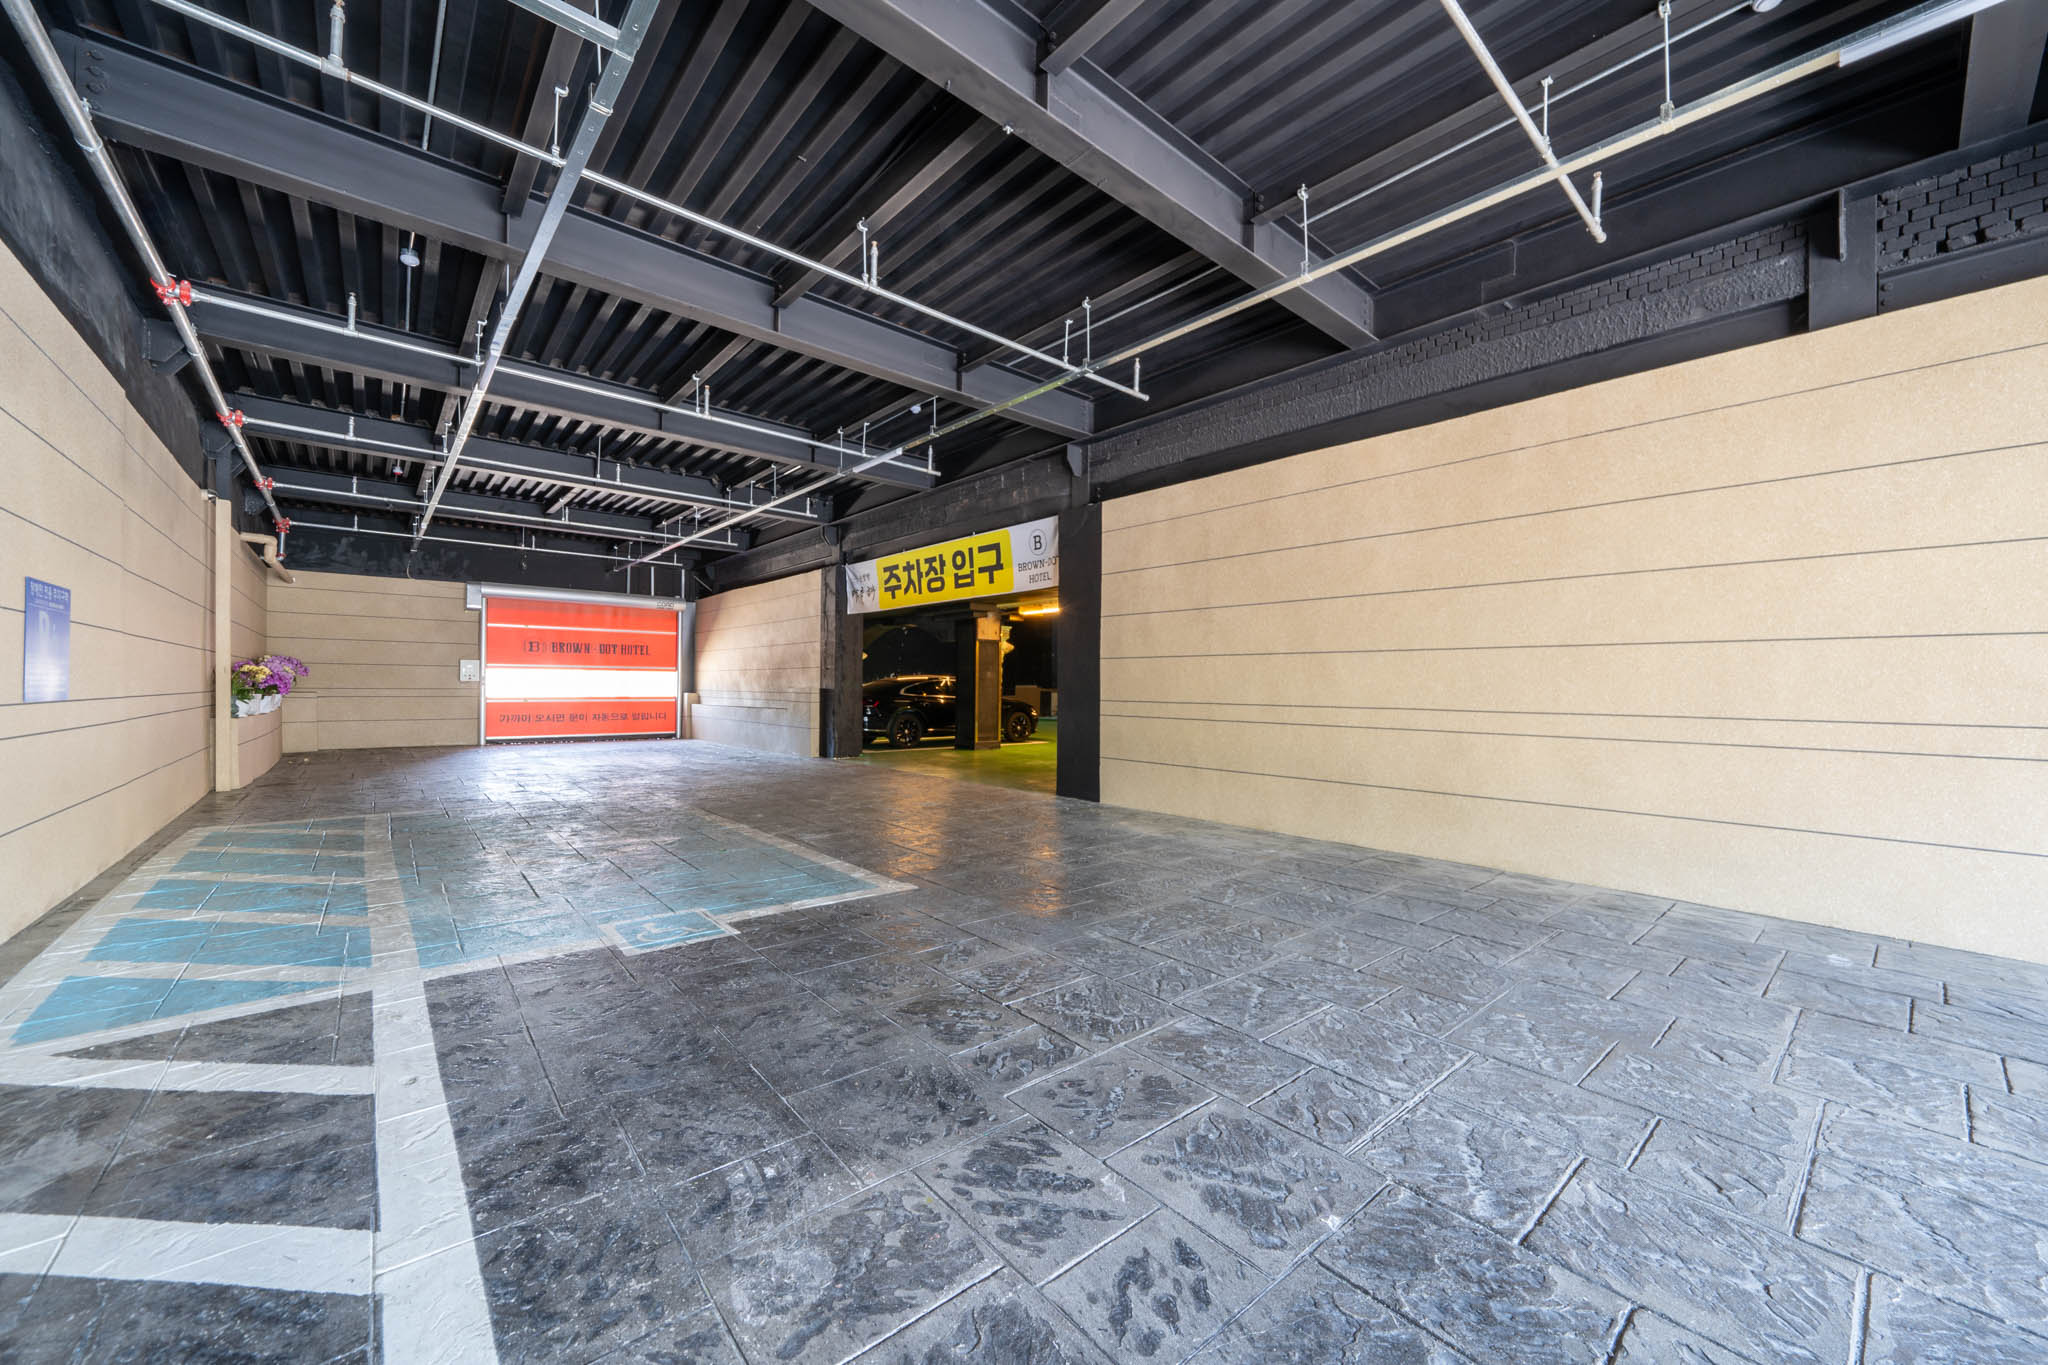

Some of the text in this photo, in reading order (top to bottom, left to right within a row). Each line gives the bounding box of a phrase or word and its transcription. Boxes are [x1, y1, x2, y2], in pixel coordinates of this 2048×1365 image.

[1033, 535, 1043, 551] B
[883, 542, 1004, 600] 주차장 입구
[1029, 572, 1053, 584] HOTEL
[620, 644, 651, 656] HOTEL
